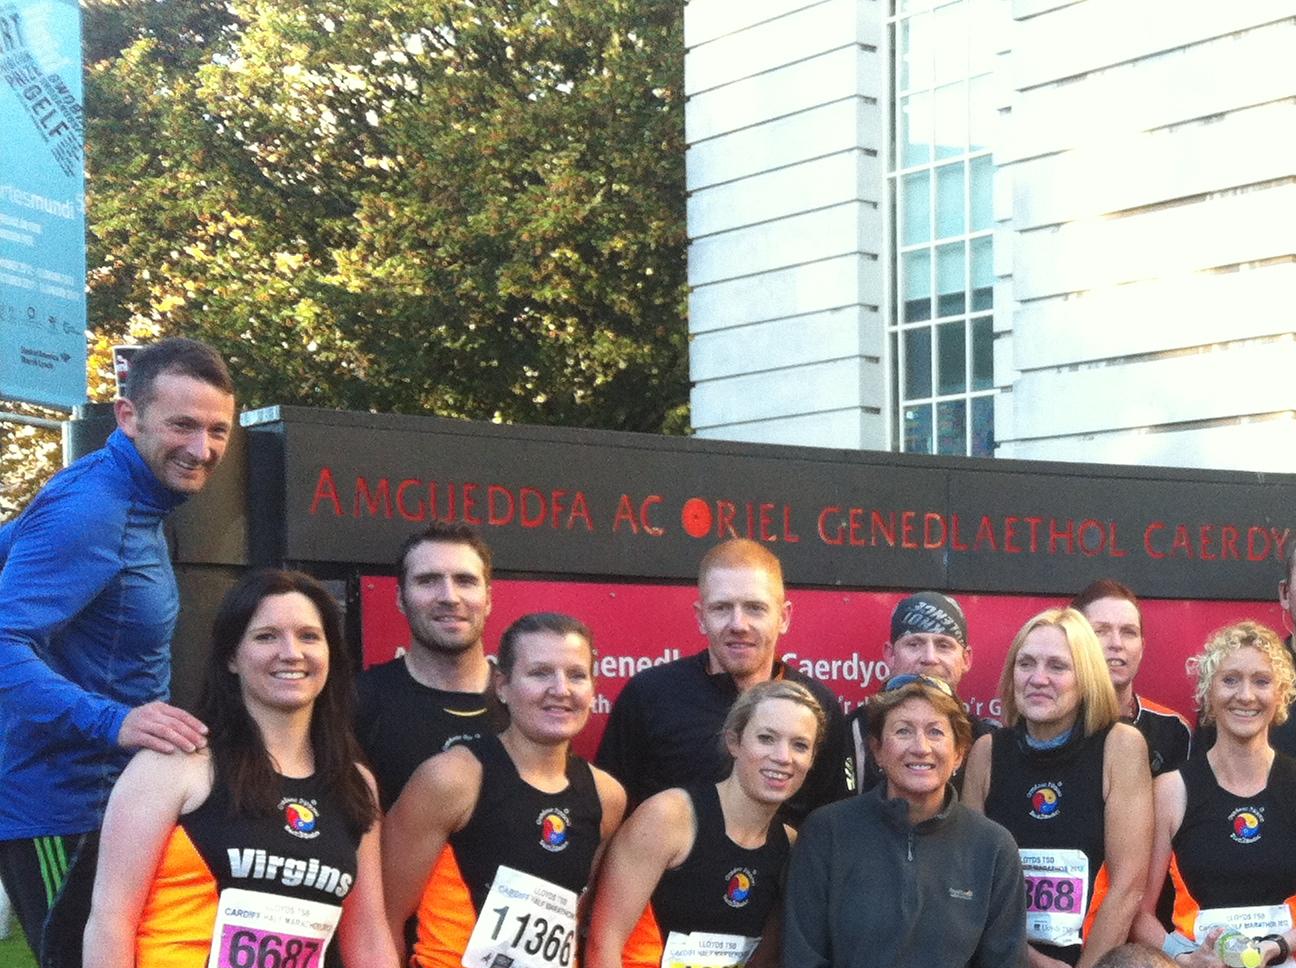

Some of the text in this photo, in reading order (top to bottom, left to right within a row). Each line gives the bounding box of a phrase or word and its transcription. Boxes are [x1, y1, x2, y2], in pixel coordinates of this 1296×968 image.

[310, 466, 595, 534] AMGUEDDFA
[612, 493, 665, 537] AC
[681, 496, 800, 544] ORIEL
[817, 505, 1128, 560] GENEDLAETHOL
[227, 847, 352, 897] Virgins
[490, 905, 575, 967] 11366
